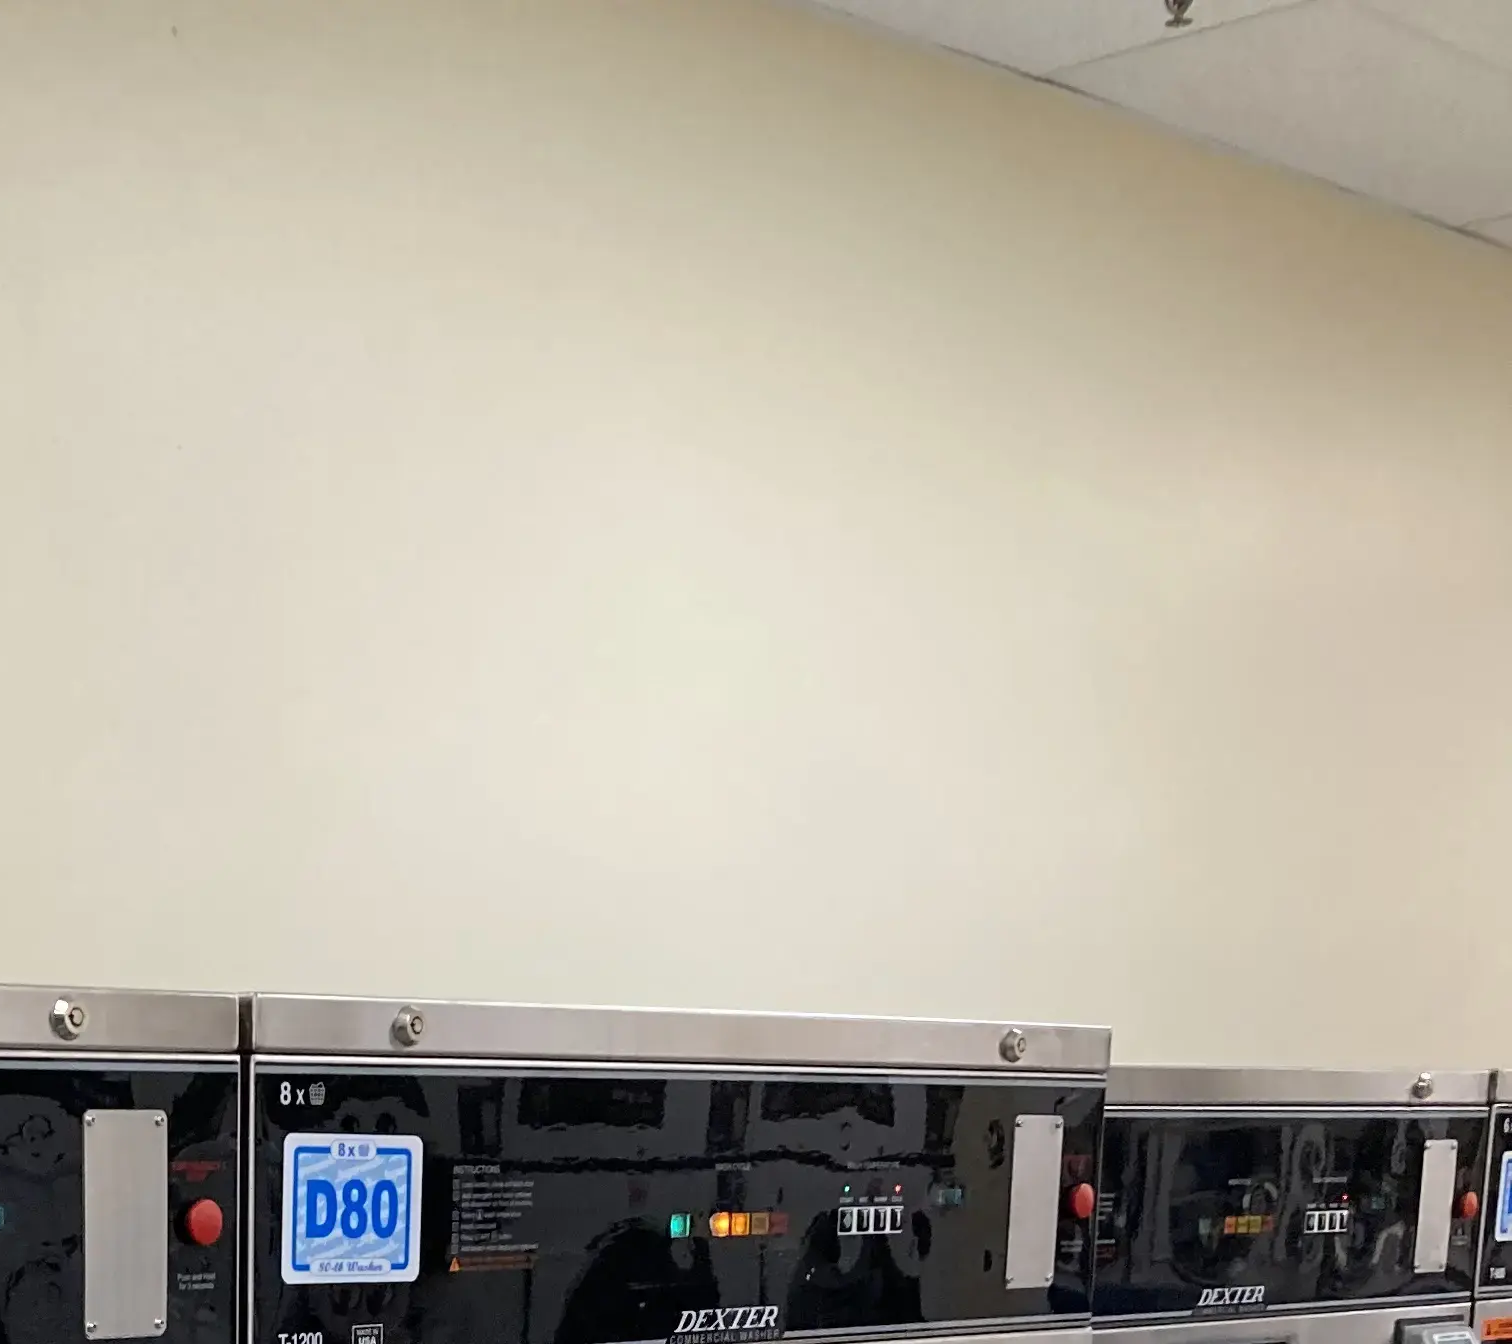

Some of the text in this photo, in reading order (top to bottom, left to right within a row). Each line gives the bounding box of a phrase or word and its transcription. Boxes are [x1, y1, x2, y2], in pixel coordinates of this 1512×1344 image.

[280, 1082, 305, 1105] 8 x
[338, 1143, 356, 1157] 8 x
[305, 1178, 398, 1239] D80
[347, 1260, 383, 1272] Washer
[1197, 1285, 1265, 1306] DEXTER
[674, 1305, 779, 1333] DEXTER
[740, 1329, 779, 1341] WASHER
